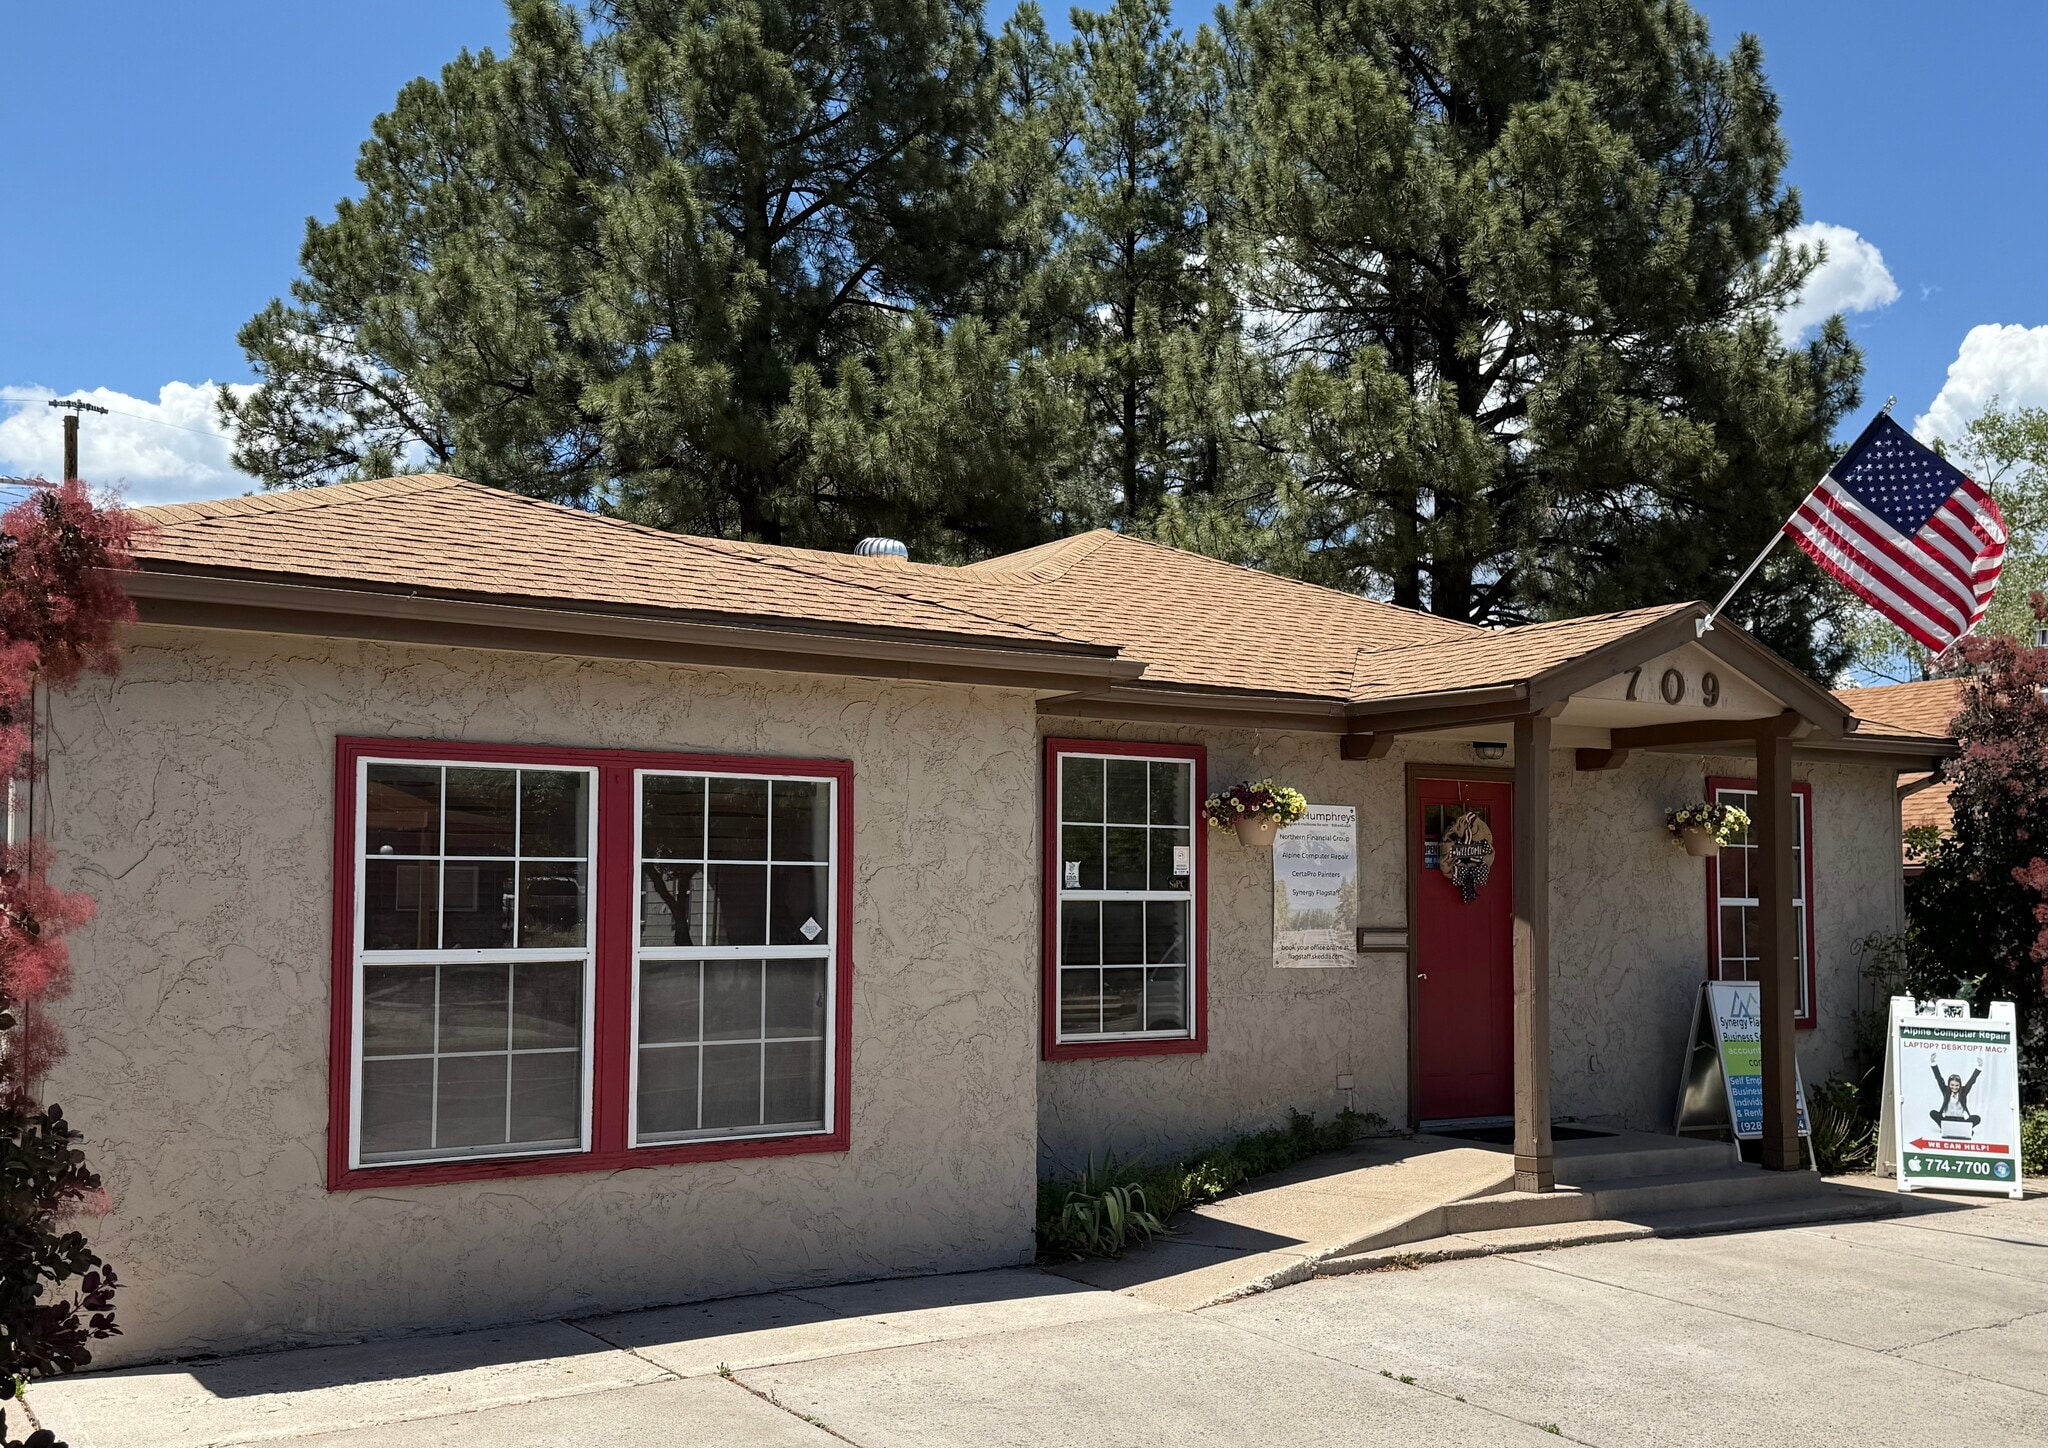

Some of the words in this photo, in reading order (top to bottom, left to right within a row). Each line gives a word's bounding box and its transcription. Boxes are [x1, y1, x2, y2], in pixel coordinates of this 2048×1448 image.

[1624, 666, 1720, 707] 709
[1279, 833, 1306, 841] Northern
[1332, 835, 1350, 843] Group
[1282, 852, 1300, 860] Alpine
[1301, 852, 1330, 860] Computer
[1330, 853, 1349, 861] Repair
[1455, 845, 1483, 857] WELCOME
[1291, 870, 1317, 878] CertaPro
[1292, 889, 1315, 897] Synergy
[1316, 889, 1341, 897] Flagstaff
[1720, 1016, 1748, 1029] Synergy
[1748, 1016, 1760, 1028] Fla
[1723, 1032, 1754, 1043] Business
[1903, 1027, 1932, 1036] Alpine
[1933, 1028, 1976, 1039] Computer
[1979, 1030, 2007, 1040] Repair
[1903, 1041, 1939, 1049] LAPTOP?
[1941, 1043, 1983, 1052] DESKTOP?
[1729, 1076, 1745, 1086] Self
[1746, 1076, 1762, 1086] Emp
[1737, 1109, 1743, 1118] &
[1741, 1121, 1763, 1133] (928
[1928, 1141, 1941, 1149] WE
[1943, 1142, 1962, 1150] CAN
[1964, 1143, 1990, 1152] HELP!
[1925, 1158, 1991, 1175] 774-7700
